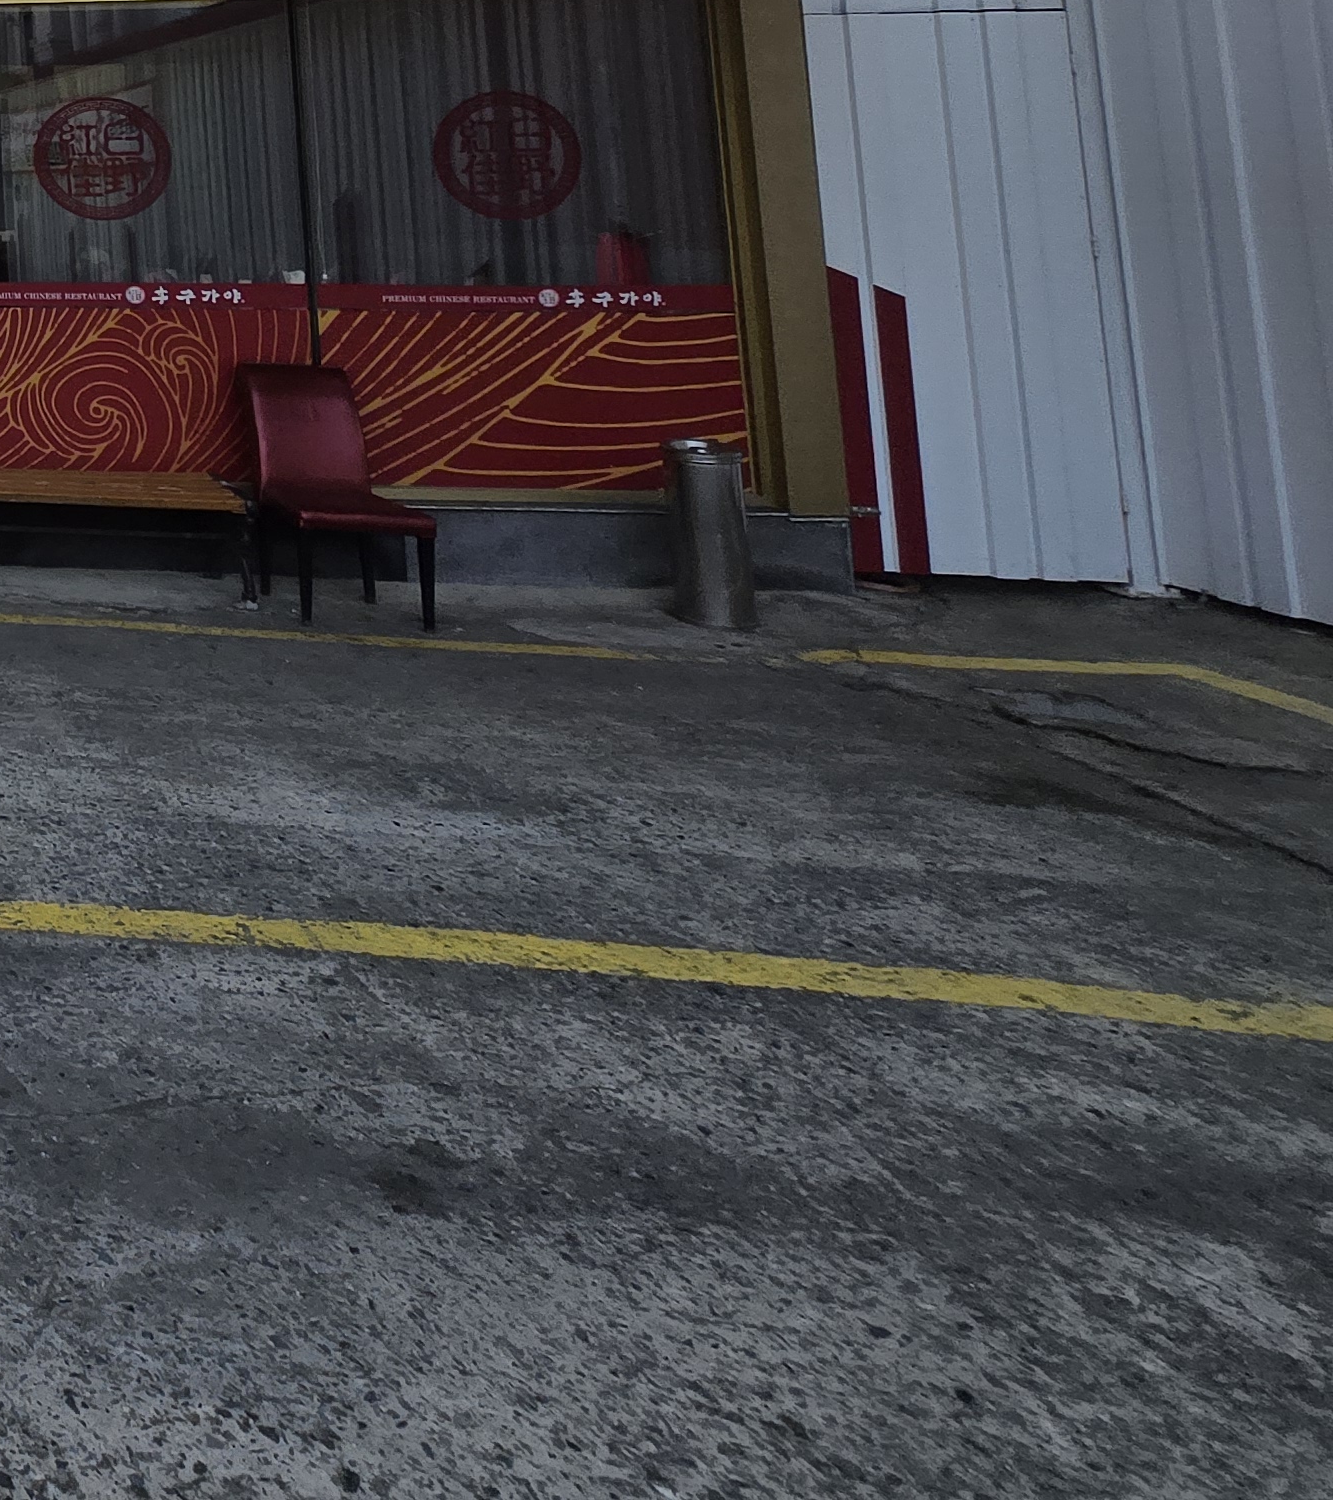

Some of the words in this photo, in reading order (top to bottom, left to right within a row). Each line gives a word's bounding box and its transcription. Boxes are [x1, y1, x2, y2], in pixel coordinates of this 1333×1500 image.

[24, 292, 62, 300] CHINESE
[64, 292, 123, 301] RESTAURANT
[382, 294, 427, 303] PREMIUM
[429, 295, 470, 304] CHINESE
[473, 295, 536, 304] RESTAURANT
